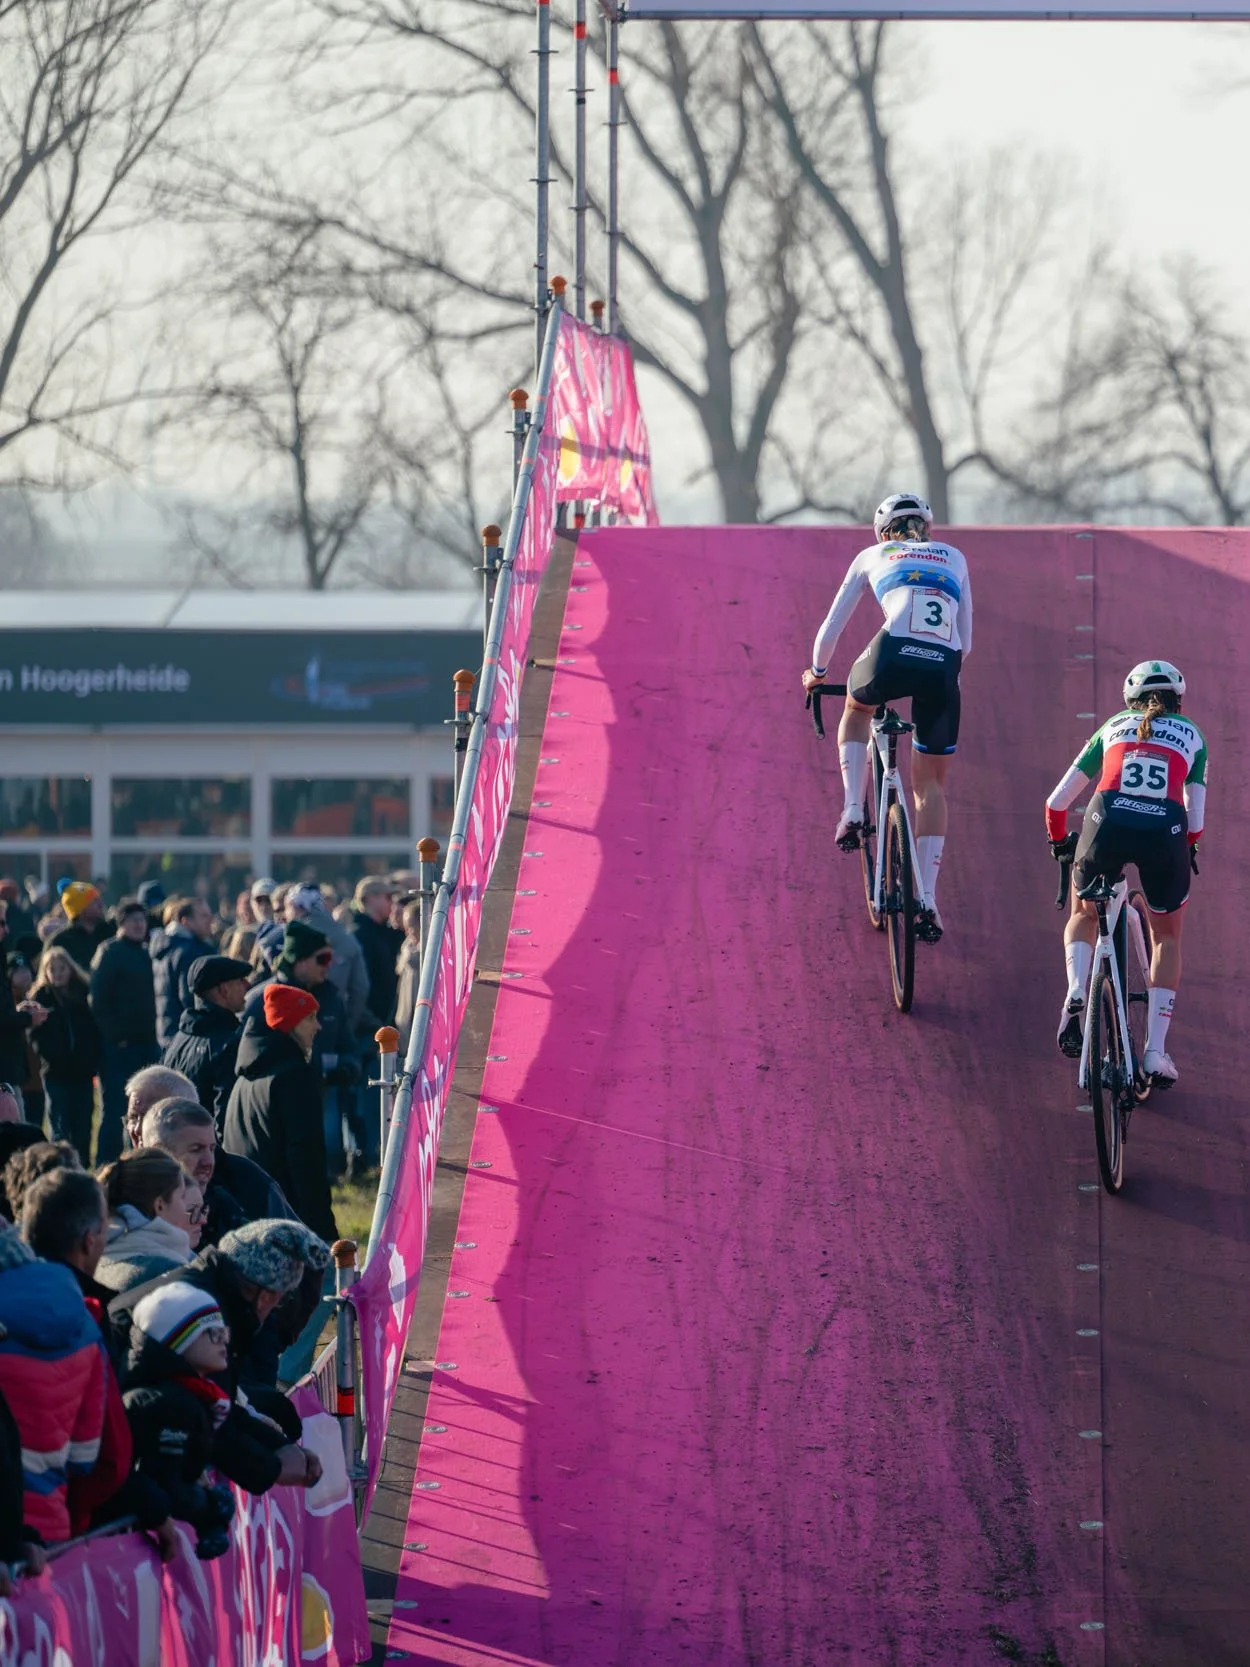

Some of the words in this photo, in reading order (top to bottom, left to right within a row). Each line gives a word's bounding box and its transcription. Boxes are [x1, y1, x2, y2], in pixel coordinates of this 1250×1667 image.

[924, 600, 943, 627] 3
[0, 671, 13, 692] n
[21, 663, 191, 698] Hoogerheide
[1133, 715, 1194, 741] celan
[1122, 762, 1167, 790] 35
